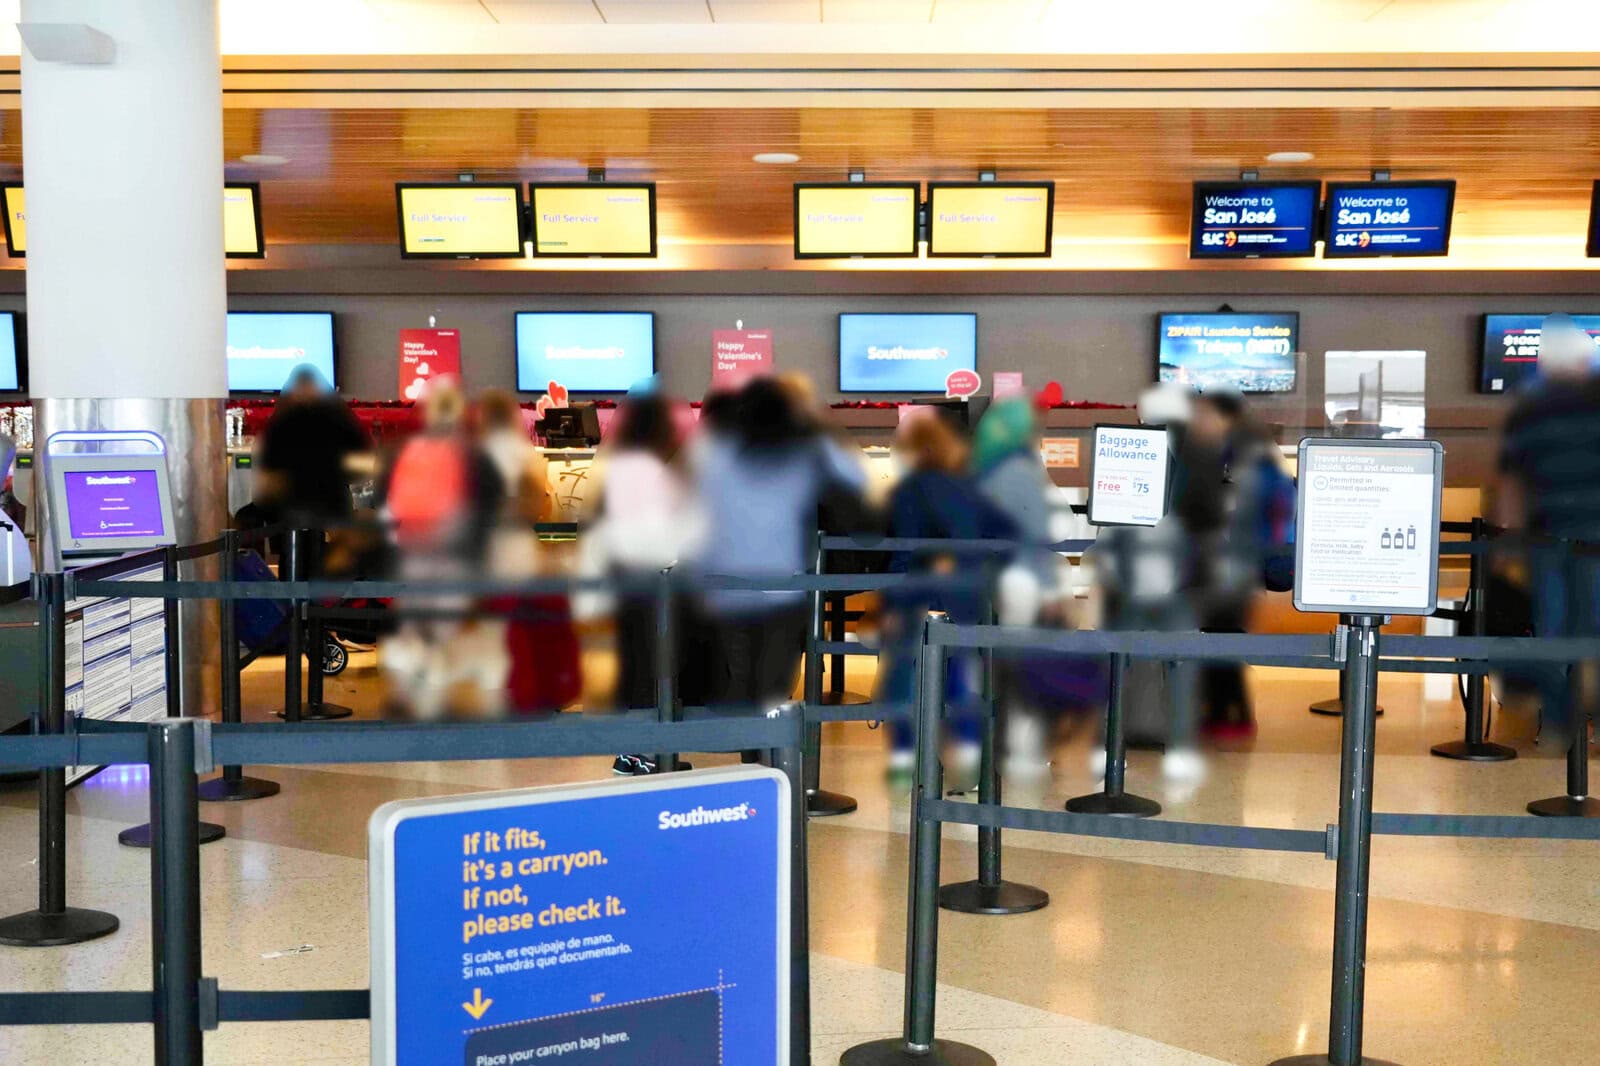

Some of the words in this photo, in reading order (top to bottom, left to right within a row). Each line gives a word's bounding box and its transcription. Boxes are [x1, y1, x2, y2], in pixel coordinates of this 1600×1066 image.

[1205, 196, 1258, 206] Welcome
[1261, 197, 1273, 206] to
[1339, 197, 1393, 207] Welcome
[1395, 197, 1407, 206] to
[412, 213, 429, 222] Full
[432, 213, 467, 222] Service
[543, 214, 560, 222] Full
[564, 214, 599, 222] Service
[808, 214, 824, 222] Full
[828, 214, 864, 222] Service
[940, 214, 957, 222] Full
[960, 214, 996, 222] Service
[1204, 208, 1237, 223] San
[1239, 208, 1276, 223] José
[1337, 209, 1371, 224] San
[1373, 208, 1410, 223] José
[1202, 232, 1224, 245] SJC
[1335, 233, 1358, 246] SJC
[1203, 326, 1251, 336] Launches
[1252, 325, 1291, 336] Service
[404, 342, 424, 350] Happy
[718, 342, 744, 351] Happy
[717, 352, 762, 360] Valentine's
[867, 346, 939, 360] Southwest
[404, 356, 419, 364] Day!
[718, 362, 736, 370] Day!
[1099, 434, 1149, 448] Baggage
[1098, 447, 1157, 460] Allowance
[1097, 481, 1121, 491] Free
[658, 805, 749, 830] Southwest
[463, 831, 481, 855] If
[484, 831, 501, 852] it
[505, 827, 546, 850] fits,
[463, 859, 496, 882] it's
[501, 861, 513, 878] a
[518, 849, 608, 876] carryon.
[463, 886, 481, 910] If
[485, 884, 528, 906] not,
[463, 912, 534, 944] please
[538, 898, 601, 926] check
[605, 895, 627, 917] it.
[462, 952, 473, 965] Si
[475, 949, 504, 964] cabe,
[505, 948, 518, 959] es
[519, 940, 566, 957] equipaje
[566, 936, 581, 949] de
[582, 934, 615, 946] mano.
[462, 966, 473, 979] Si
[475, 967, 493, 978] no,
[494, 958, 535, 974] tendrás
[536, 956, 557, 969] que
[559, 943, 632, 964] documentarlo.
[476, 1053, 506, 1066] Place
[508, 1048, 534, 1064] your
[536, 1040, 578, 1057] carryon
[579, 1036, 600, 1050] bag
[602, 1031, 629, 1045] here.
